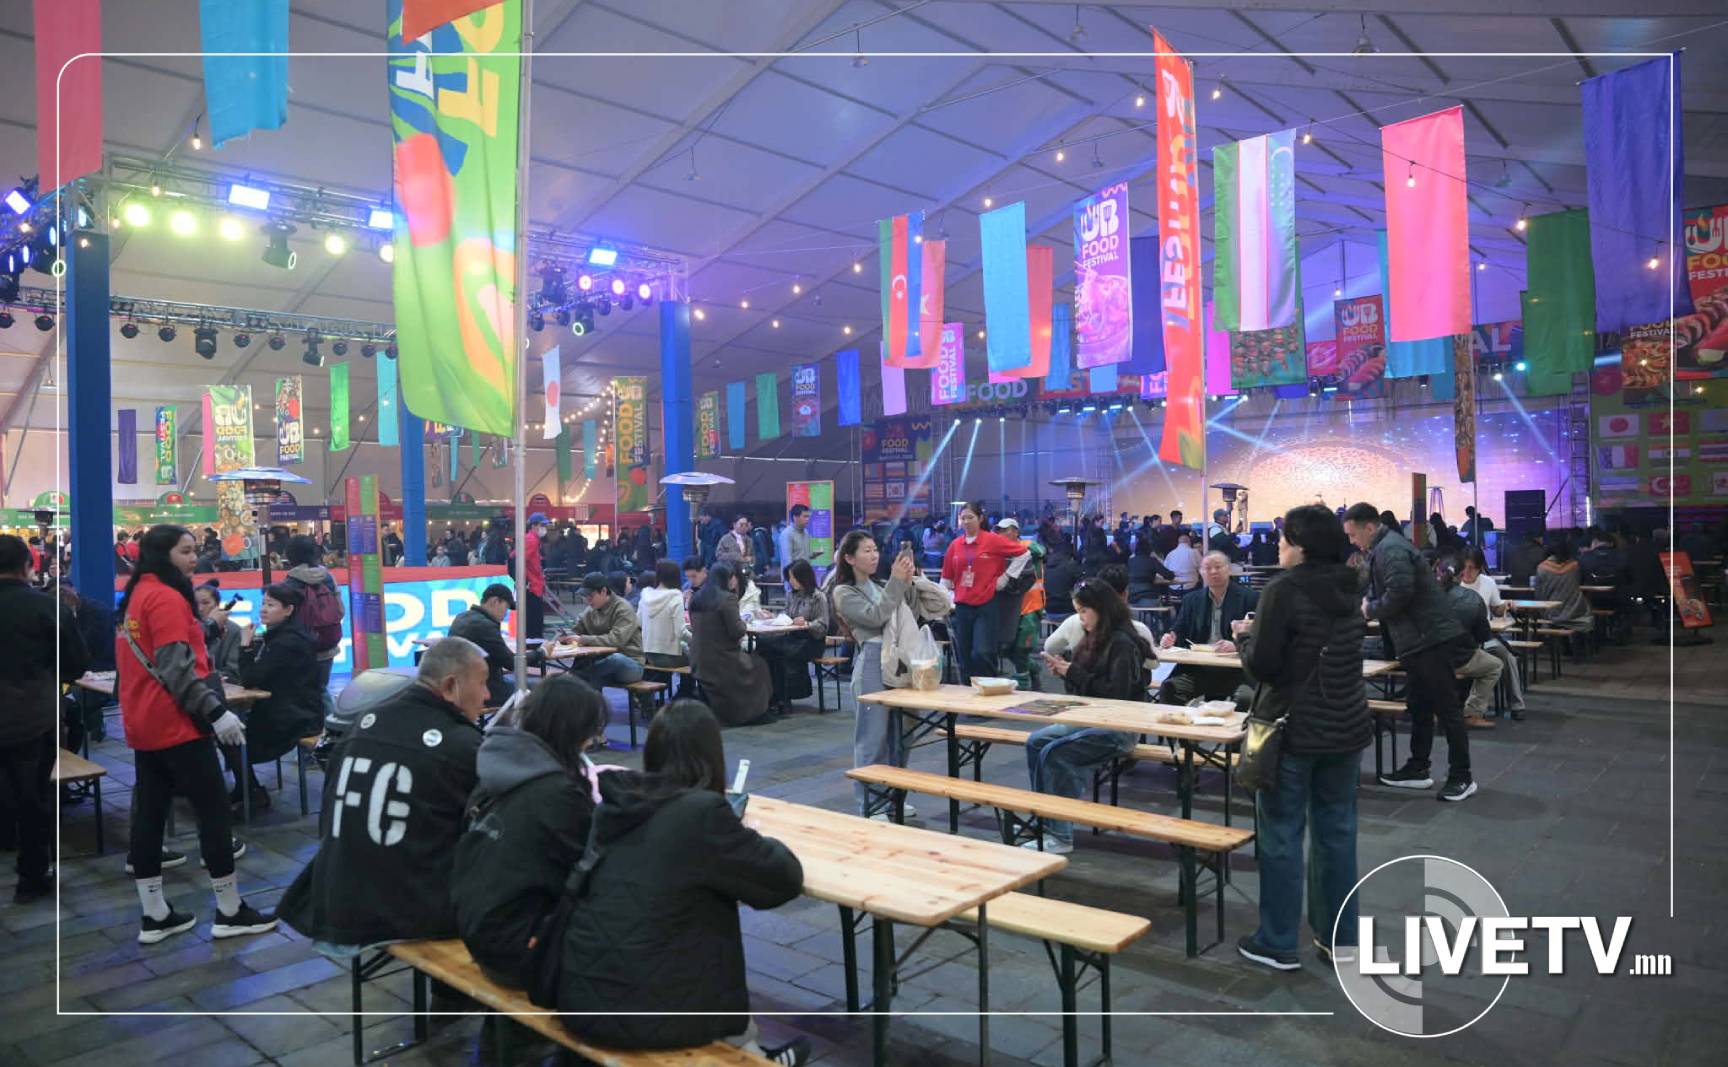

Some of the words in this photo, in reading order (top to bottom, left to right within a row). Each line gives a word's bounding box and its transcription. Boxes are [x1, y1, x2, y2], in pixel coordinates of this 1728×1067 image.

[1081, 198, 1119, 242] UB
[1082, 236, 1119, 259] FOOD
[1083, 252, 1119, 270] FESTIVAL
[1687, 253, 1728, 272] FO
[1688, 268, 1728, 281] FEST
[1342, 303, 1378, 327] UB
[1343, 324, 1377, 337] FOOD
[949, 345, 958, 398] FESTIVAL
[967, 379, 1028, 402] FOOD
[619, 402, 634, 465] FOOD
[634, 403, 643, 463] FESTIVAL
[332, 756, 413, 846] FG
